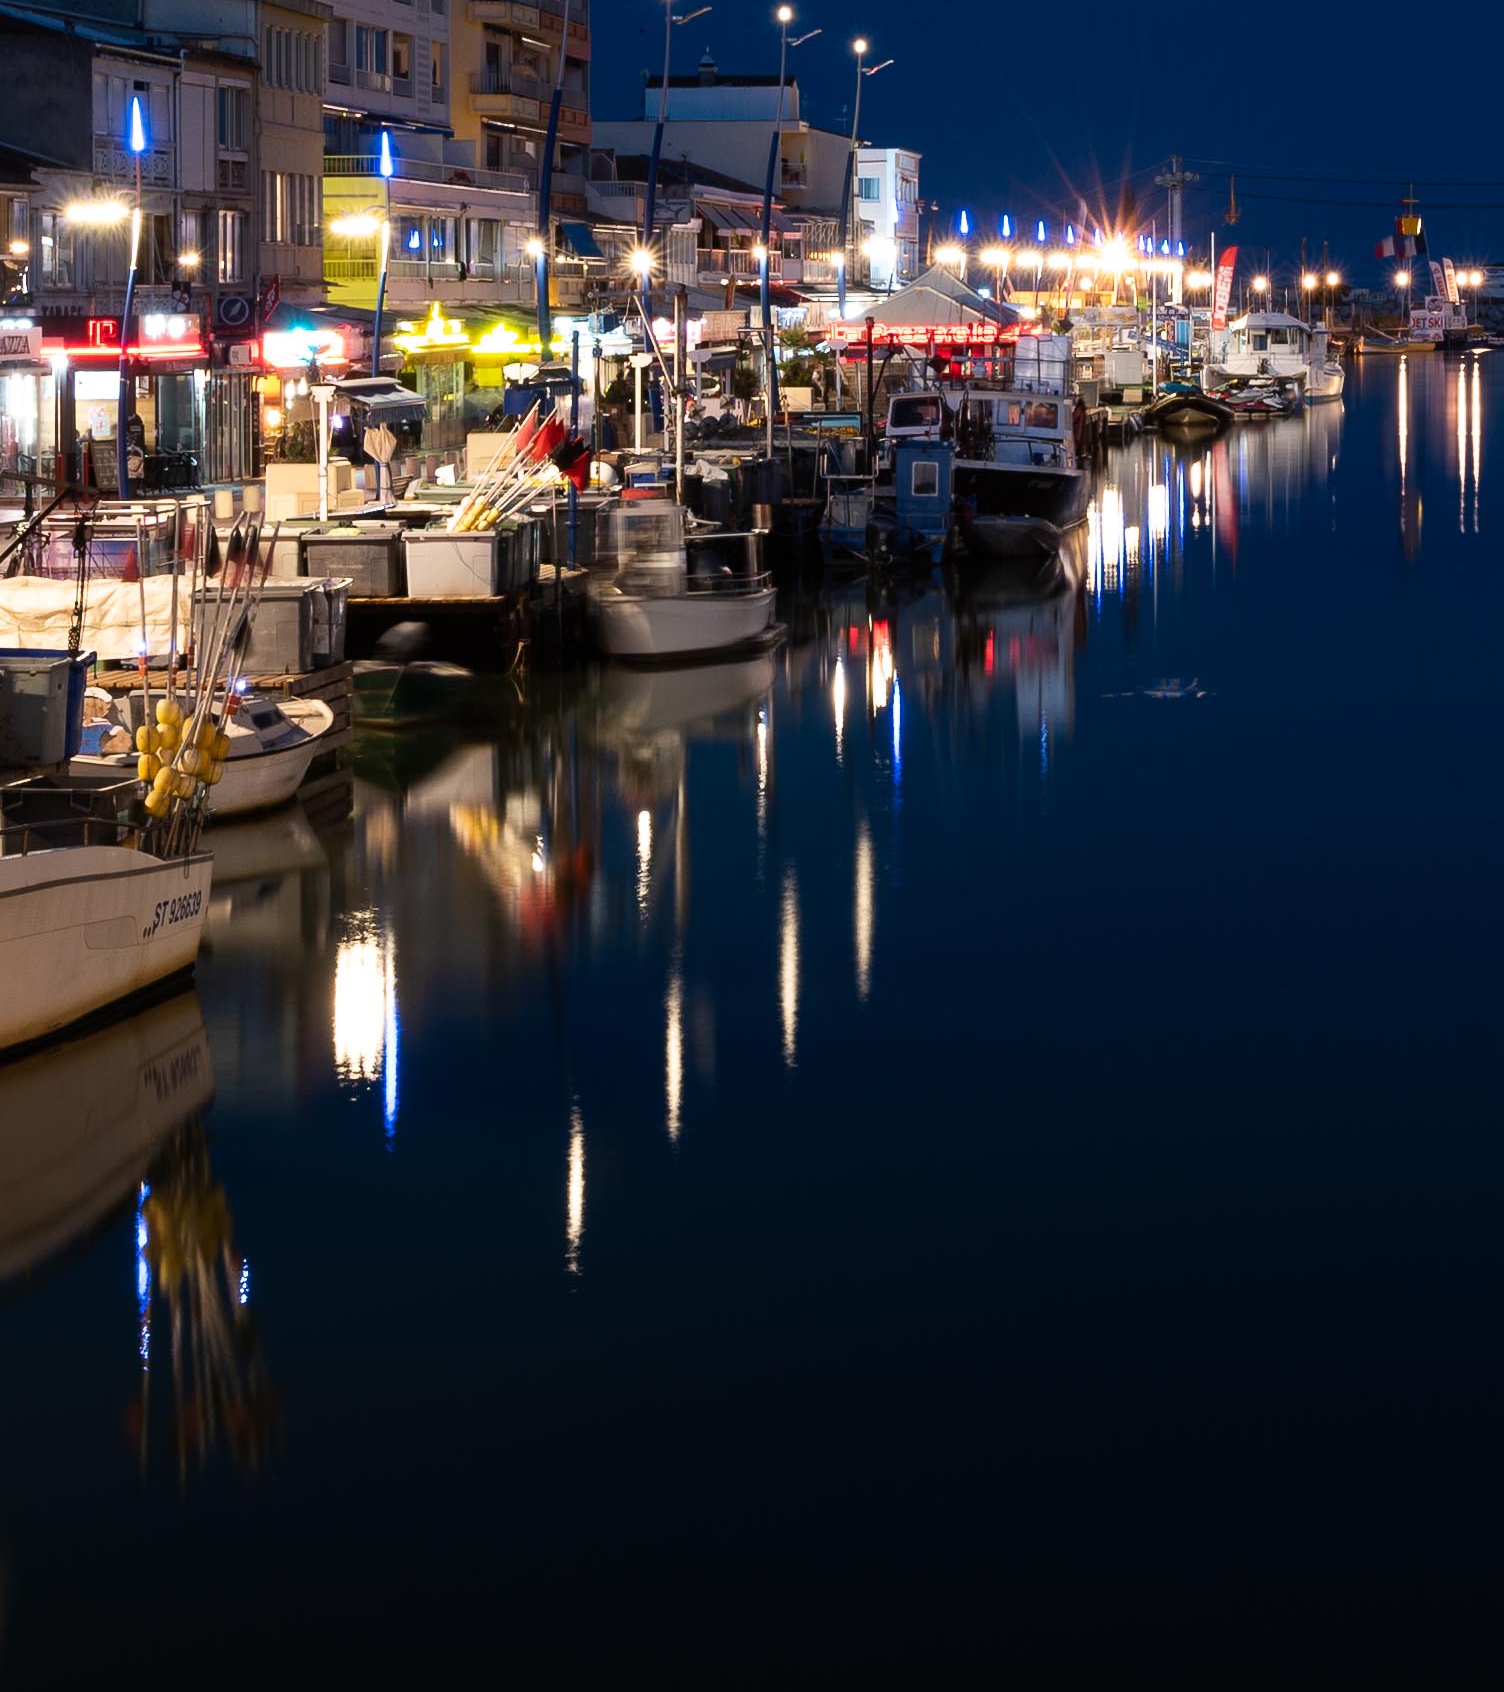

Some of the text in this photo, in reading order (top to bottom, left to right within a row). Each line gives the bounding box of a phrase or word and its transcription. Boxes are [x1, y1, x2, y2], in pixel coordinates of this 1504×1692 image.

[1411, 317, 1427, 329] JET
[1428, 316, 1444, 328] SKI
[154, 889, 202, 927] ST 926639
